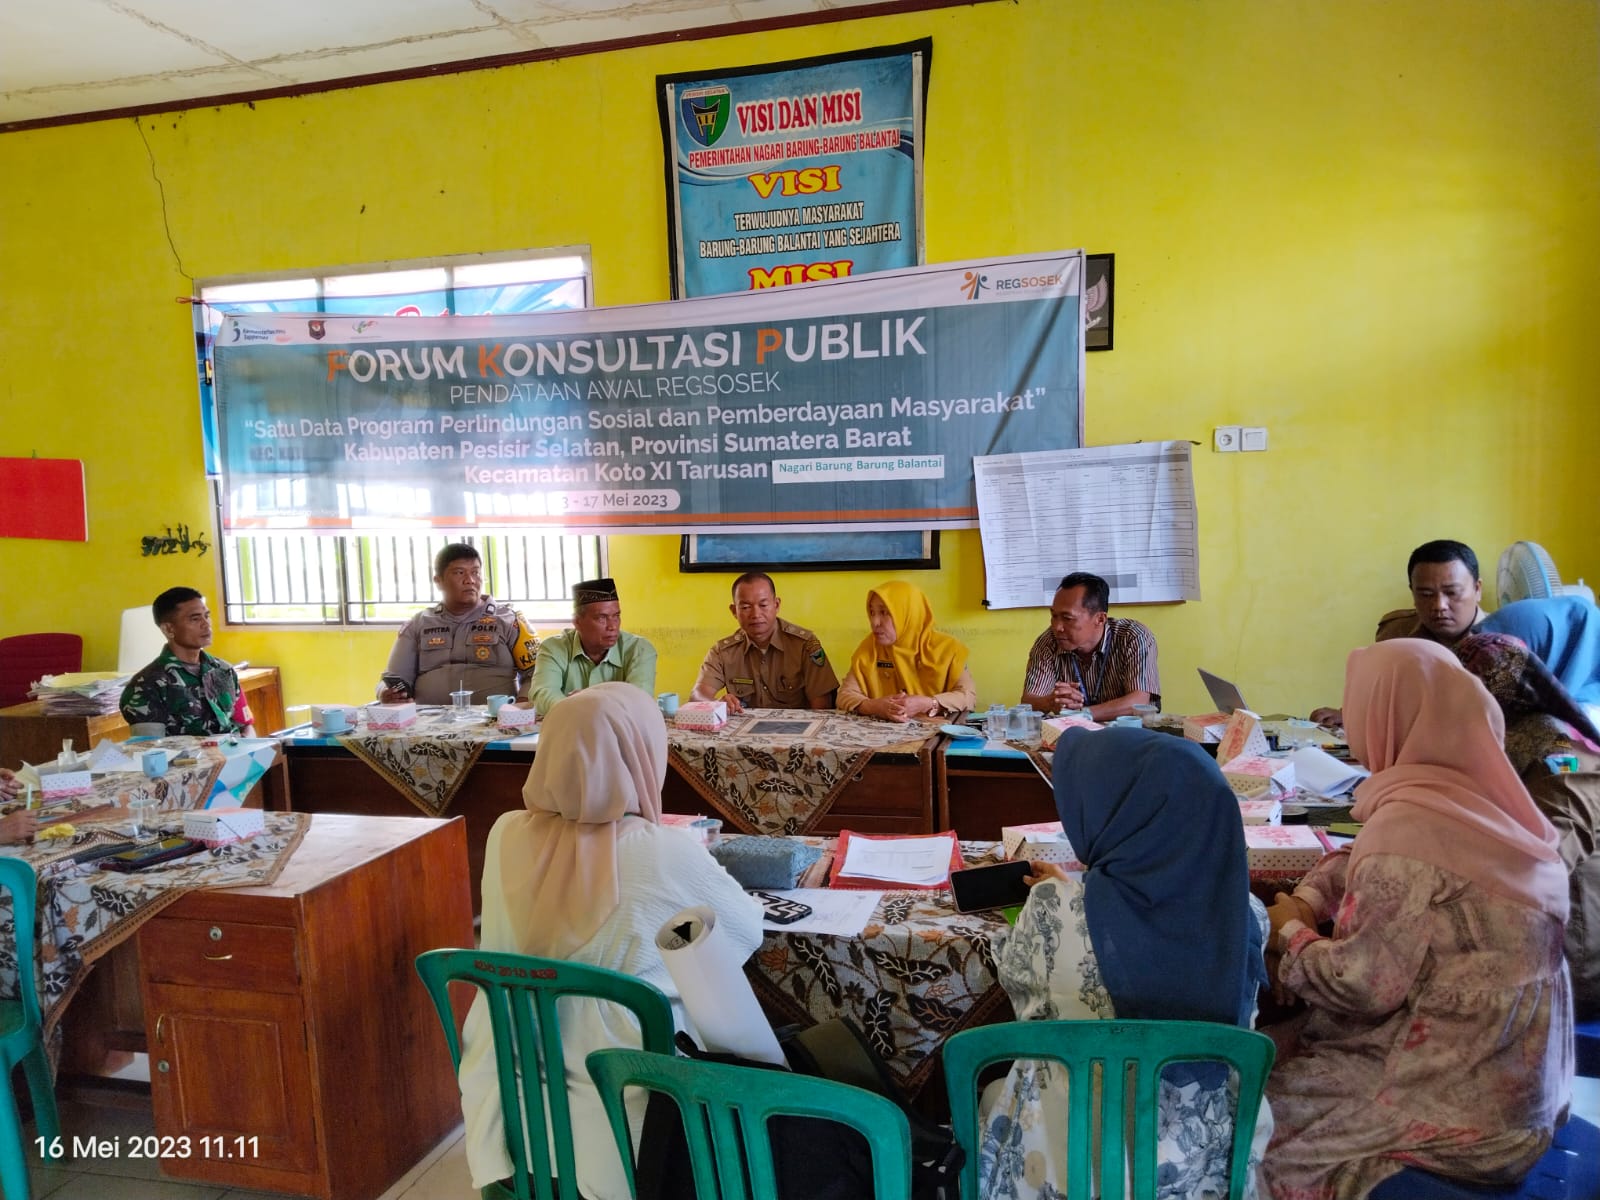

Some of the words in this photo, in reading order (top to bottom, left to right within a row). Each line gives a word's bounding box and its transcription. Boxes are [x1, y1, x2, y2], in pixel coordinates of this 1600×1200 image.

[736, 102, 775, 134] VISI
[778, 97, 818, 129] DAN
[821, 91, 862, 125] MISI
[689, 145, 751, 168] PEMERINTAHAN
[753, 143, 784, 162] NAGARI
[786, 134, 857, 158] BARUNG-BARUNG
[859, 129, 900, 149] BALANTAI
[748, 165, 842, 199] VISI
[734, 208, 800, 232] TERWUJUDNYA
[802, 201, 864, 226] MASYARAKAT
[699, 237, 775, 259] BARUNG-BARUNG
[777, 232, 821, 253] BALANTAI
[823, 229, 847, 248] YANG
[849, 222, 902, 246] SEJAHTERA
[748, 260, 854, 290] MISI
[996, 274, 1063, 290] REGSOSEK
[327, 346, 467, 383] FORUM
[478, 331, 741, 378] KONSULTASI
[756, 316, 927, 365] PUBLIK
[450, 382, 580, 405] PENDATAAN
[587, 378, 652, 400] AWAL
[656, 371, 781, 397] REGSOSEK
[300, 418, 344, 437] Data
[347, 416, 434, 437] Program
[441, 412, 582, 435] Perlindungan
[588, 408, 653, 430] Sosial
[658, 407, 700, 427] dan
[707, 401, 883, 426] Pemberdayaan
[344, 442, 453, 464] Kabupaten
[460, 440, 530, 459] Pesisir
[535, 438, 625, 460] Selatan,
[631, 433, 718, 455] Provinsi
[724, 430, 839, 452] Sumatera
[845, 427, 912, 449] Barat
[465, 463, 588, 484] Kecamatan
[595, 462, 646, 482] Koto
[650, 461, 671, 481] XI
[677, 460, 768, 480] Tarusan
[779, 462, 813, 474] Nagari
[815, 461, 853, 472] Barung
[857, 459, 895, 471] Barung
[897, 457, 942, 469] Balantai
[583, 496, 598, 509] 17
[603, 493, 629, 506] Mei
[633, 494, 668, 507] 2023
[471, 624, 497, 633] POLRI
